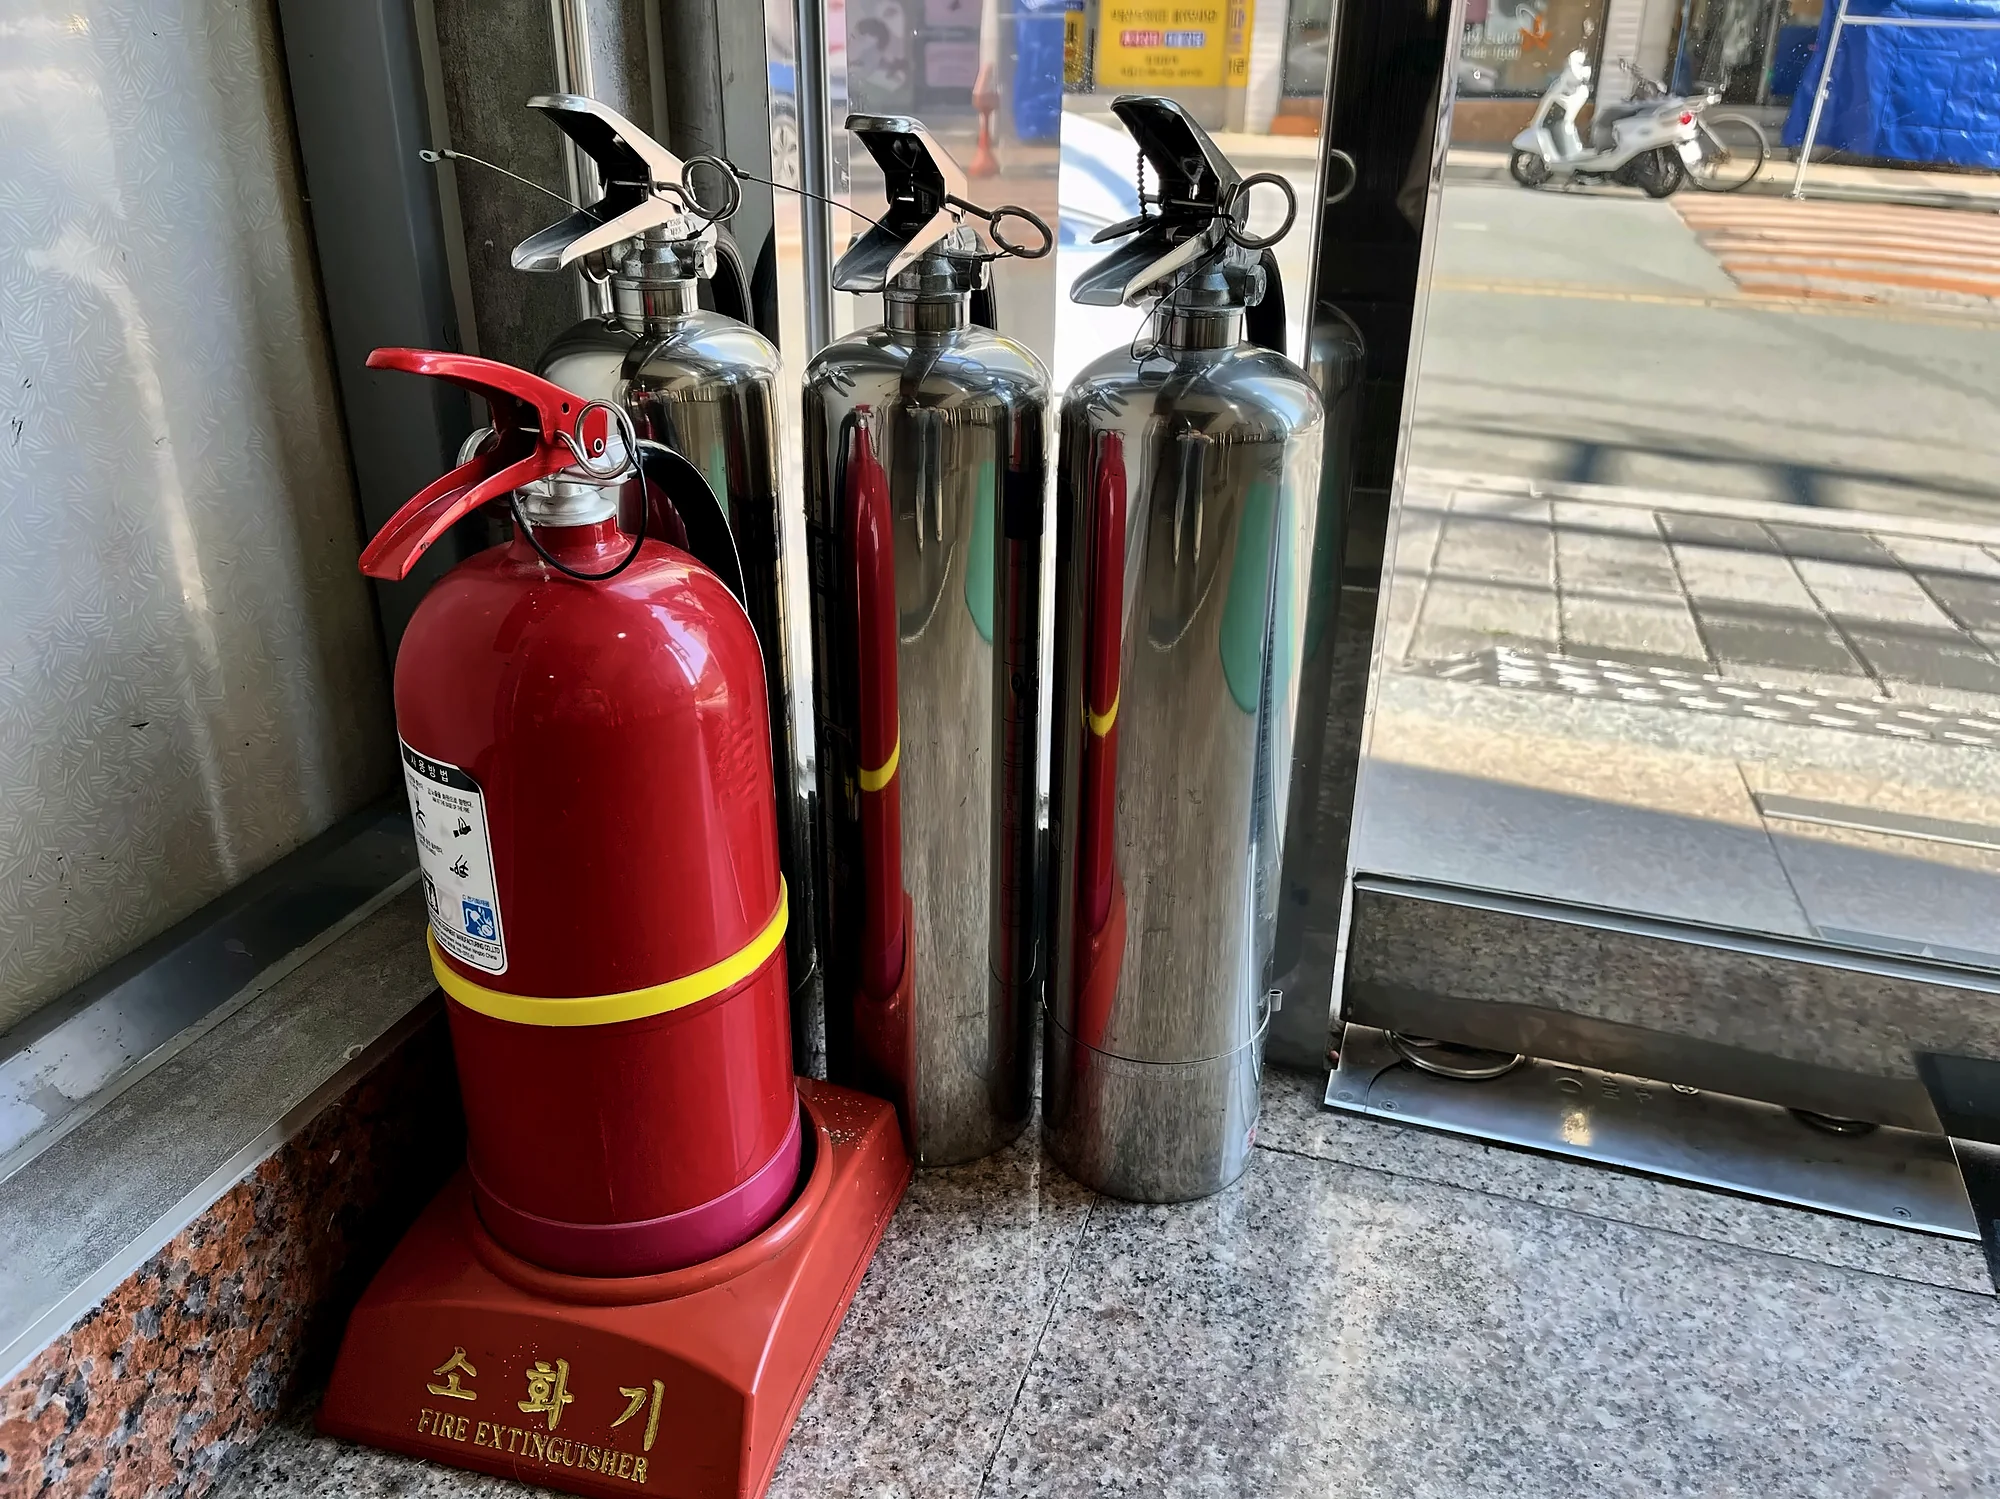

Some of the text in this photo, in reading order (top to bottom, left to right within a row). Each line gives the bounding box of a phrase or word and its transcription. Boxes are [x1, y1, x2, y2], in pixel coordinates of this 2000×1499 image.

[426, 1345, 665, 1452] 소화기
[416, 1407, 650, 1484] FIRE EXTINGUISHER
